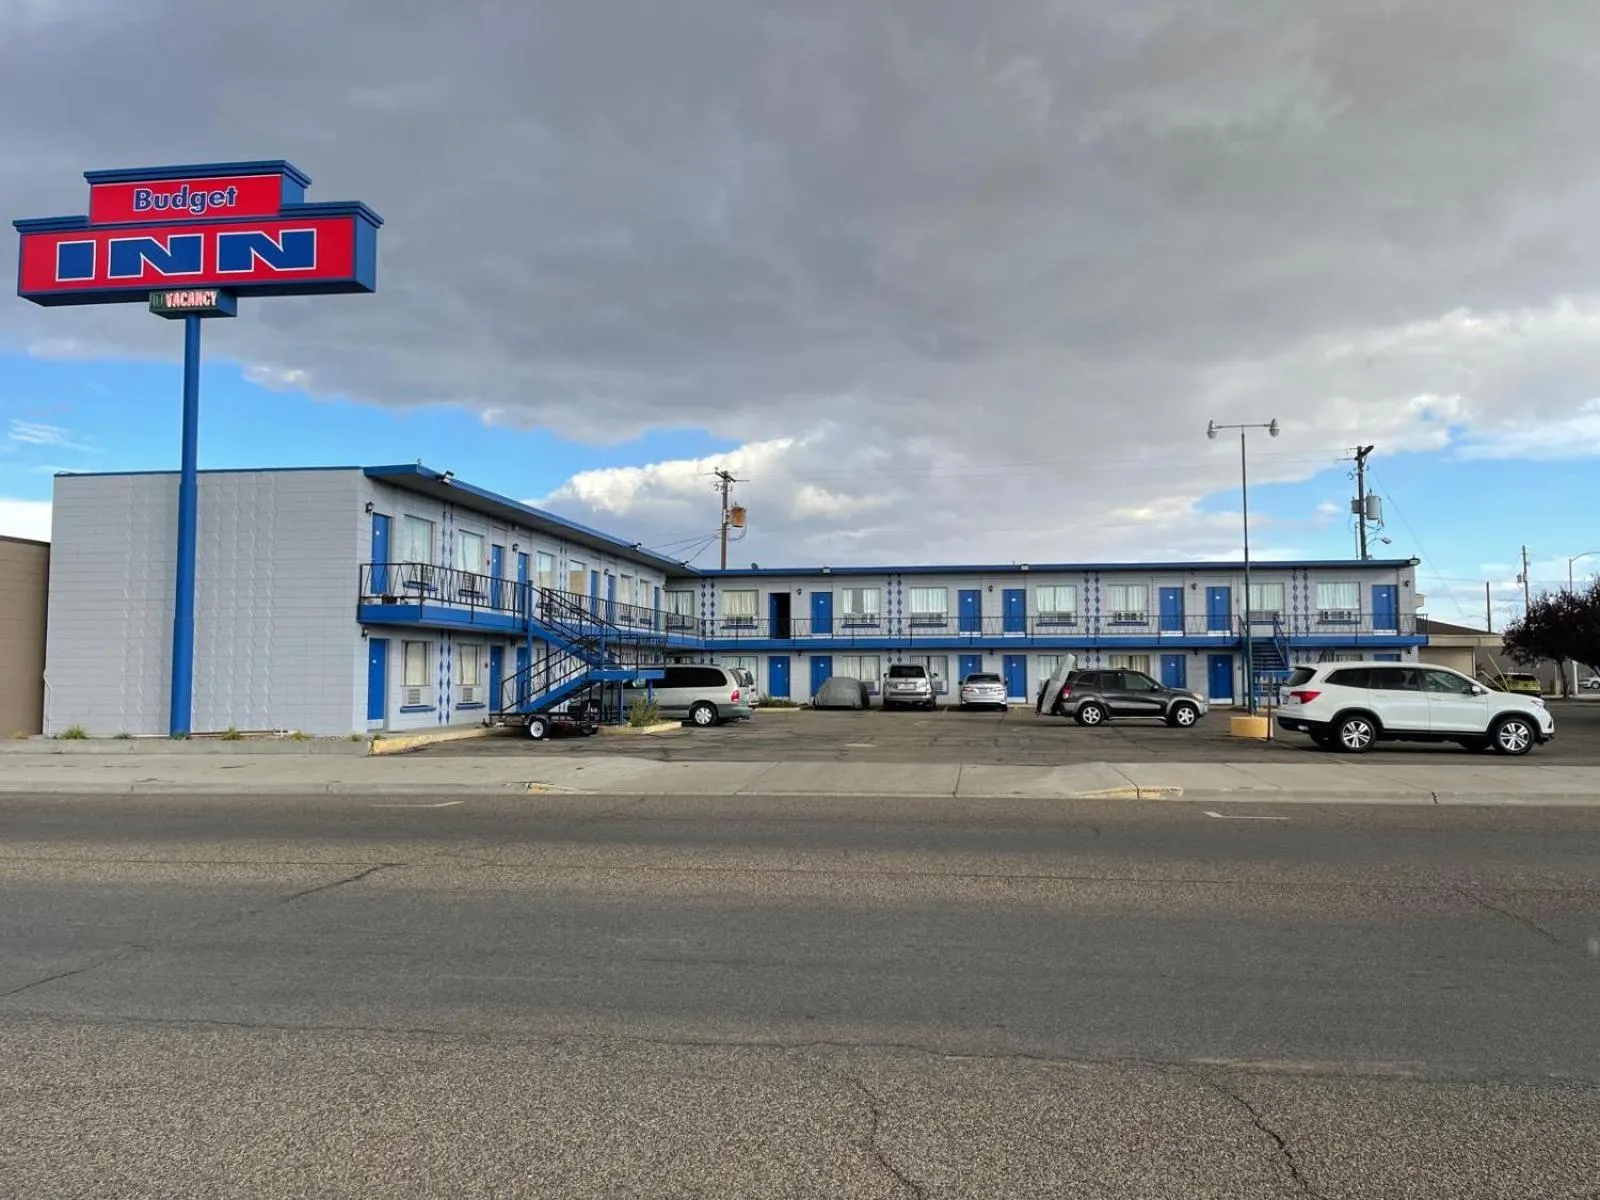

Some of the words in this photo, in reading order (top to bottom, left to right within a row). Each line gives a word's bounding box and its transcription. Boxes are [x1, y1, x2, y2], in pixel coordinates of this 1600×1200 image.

[133, 185, 237, 214] Budget
[56, 228, 317, 281] INN
[165, 290, 217, 308] VACANCY
